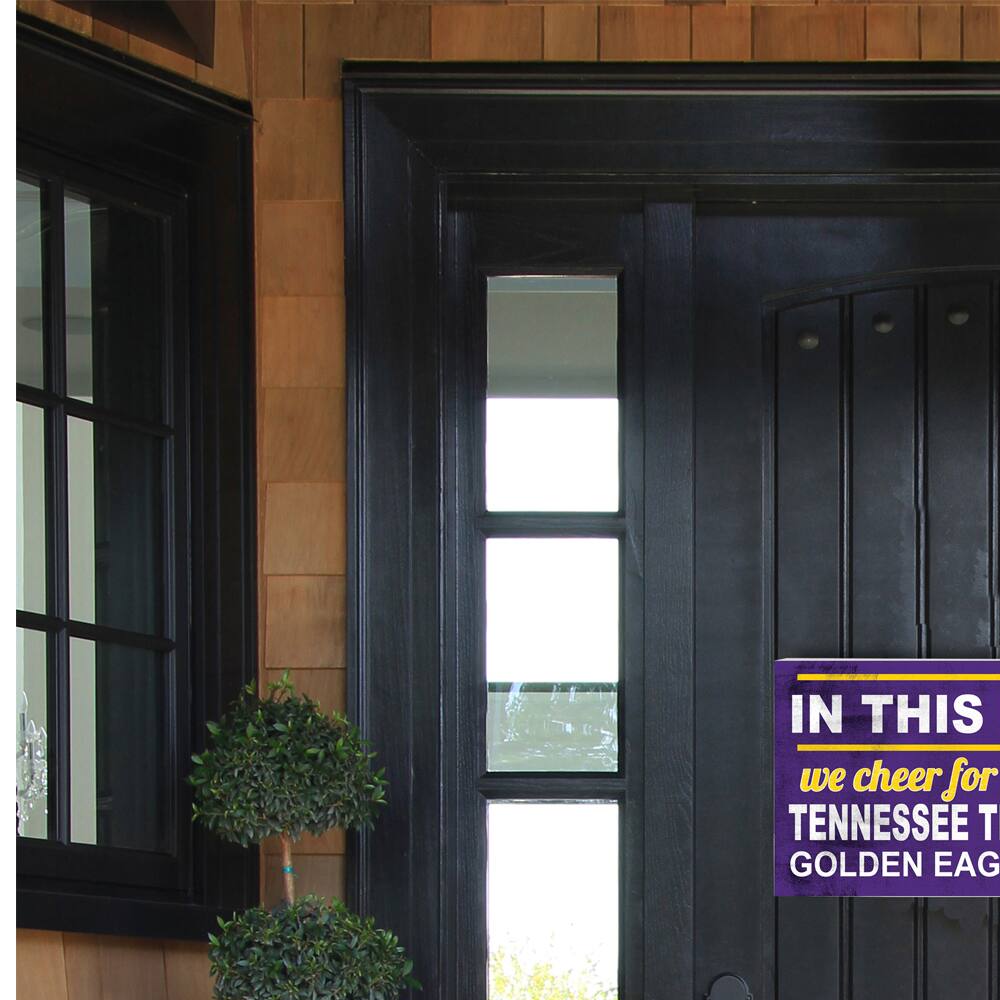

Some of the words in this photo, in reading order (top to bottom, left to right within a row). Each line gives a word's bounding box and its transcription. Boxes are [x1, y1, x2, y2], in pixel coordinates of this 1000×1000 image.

[791, 694, 843, 733] IN
[861, 694, 983, 734] THIS
[799, 768, 847, 792] we
[853, 760, 943, 792] cheer
[940, 757, 998, 802] for
[789, 803, 969, 841] TENNESSEE
[789, 850, 922, 878] GOLDEN
